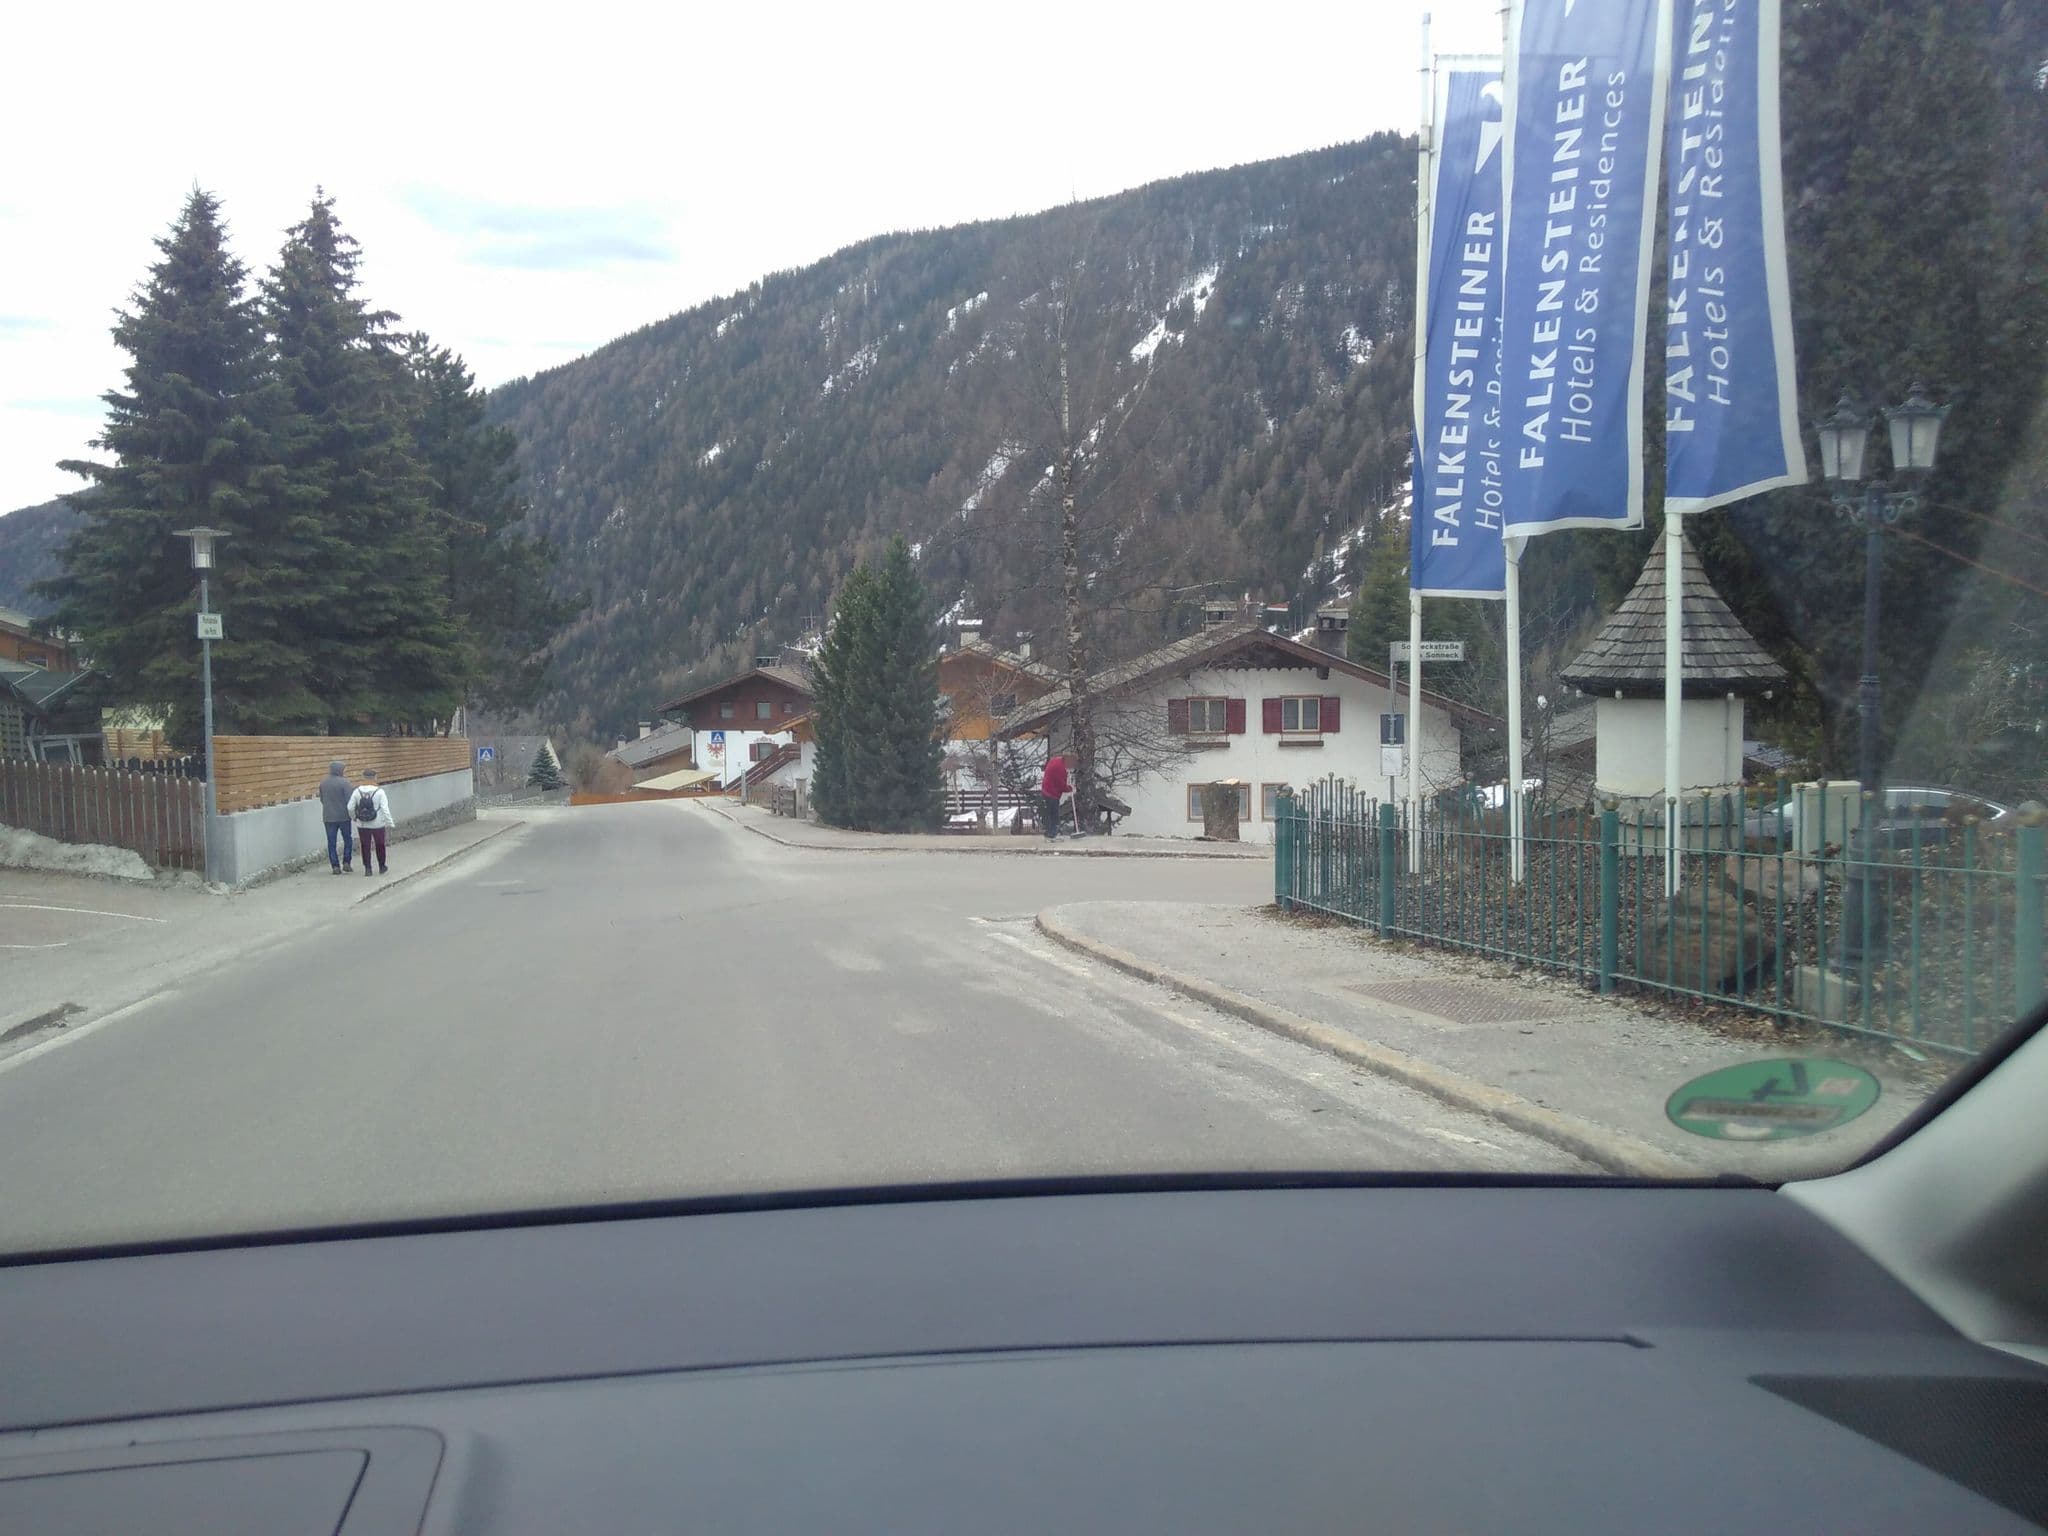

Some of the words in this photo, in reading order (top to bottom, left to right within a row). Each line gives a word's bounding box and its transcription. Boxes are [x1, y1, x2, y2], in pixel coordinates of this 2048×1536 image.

[1579, 70, 1626, 273] Residences
[1665, 0, 1714, 432] FALKENSTEIN
[1697, 215, 1724, 249] &
[1519, 55, 1588, 469] FALKENSTEINER
[1574, 286, 1599, 313] &
[1697, 266, 1732, 405] Hotels
[1431, 210, 1496, 547] FALKENSTEINER
[1559, 319, 1597, 443] Hotels
